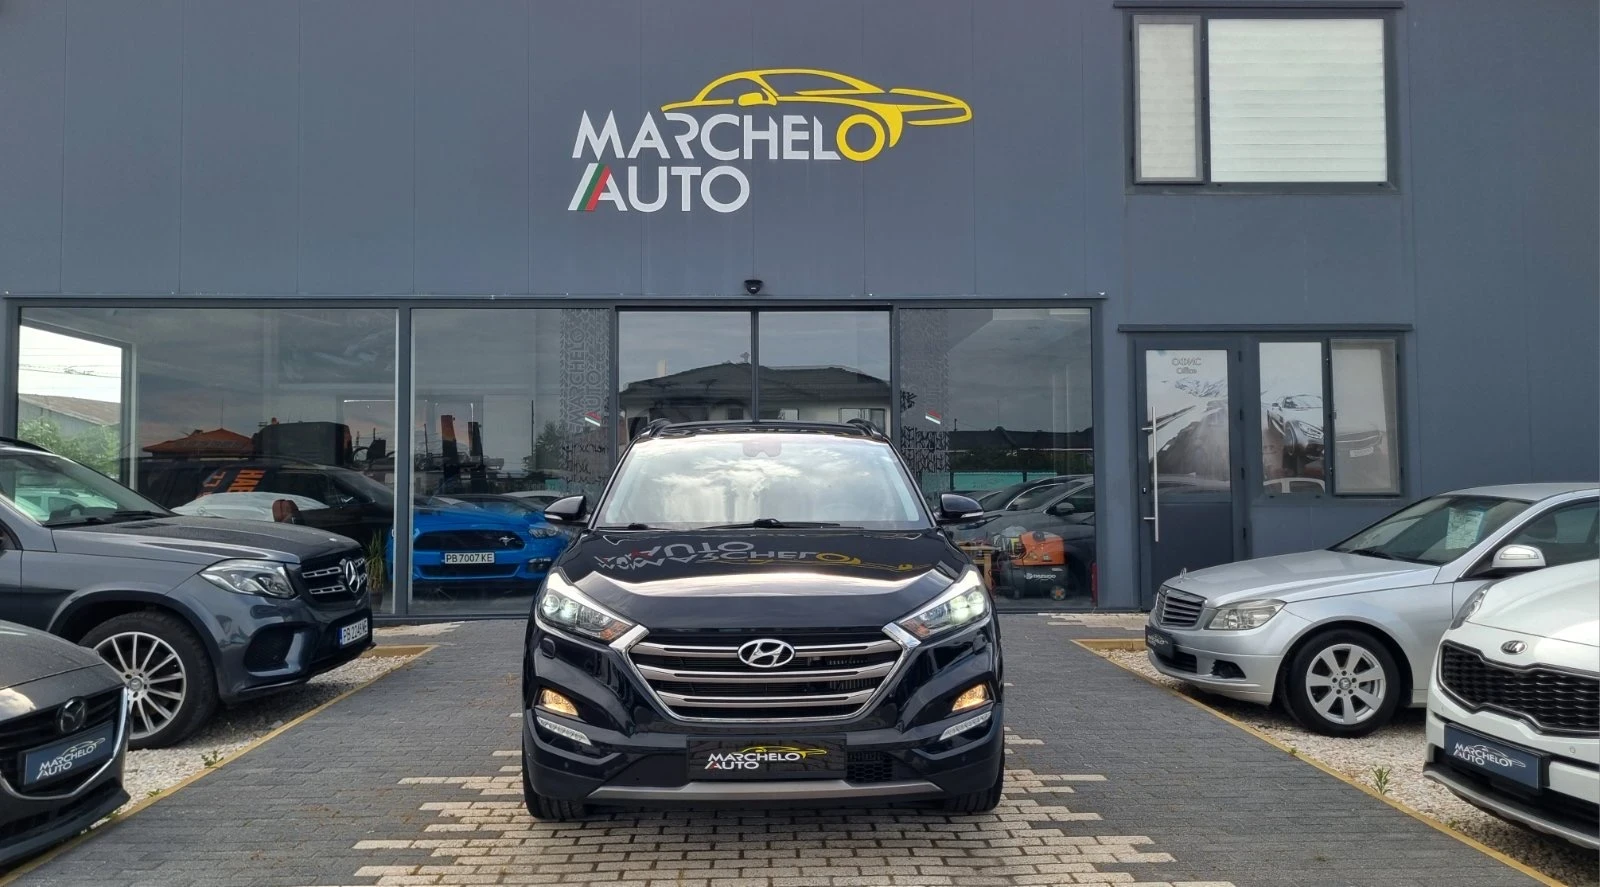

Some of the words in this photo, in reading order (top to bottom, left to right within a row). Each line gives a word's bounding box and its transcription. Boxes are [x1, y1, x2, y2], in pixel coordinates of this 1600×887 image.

[572, 109, 885, 161] MARCHELO
[568, 163, 750, 212] AUTO
[568, 328, 585, 425] MARCHELO
[584, 370, 602, 427] AUTO
[446, 554, 458, 563] PB
[459, 554, 480, 563] 7007
[481, 554, 493, 562] KE
[40, 745, 94, 771] MARCHELO
[704, 761, 759, 770] AUTO
[708, 753, 800, 761] MARCHELO
[1453, 750, 1485, 766] AUTO
[1455, 742, 1511, 767] MARCHELO
[36, 761, 73, 780] AUTO
